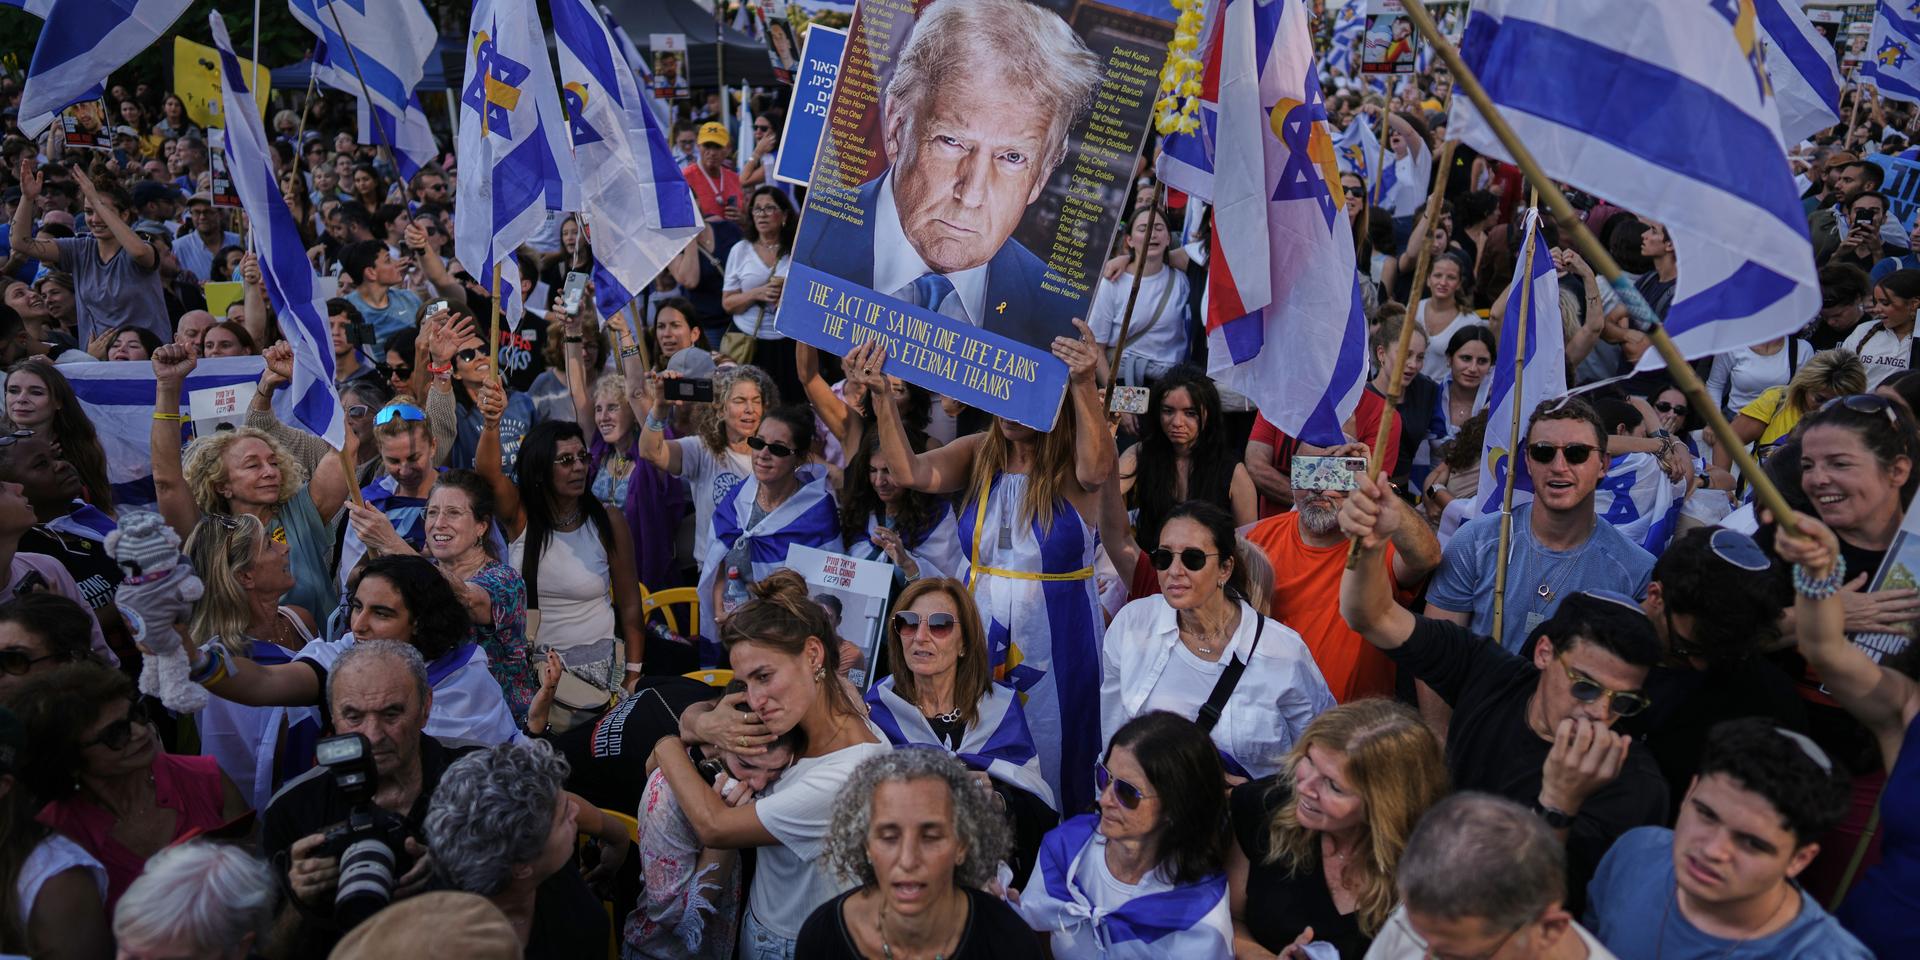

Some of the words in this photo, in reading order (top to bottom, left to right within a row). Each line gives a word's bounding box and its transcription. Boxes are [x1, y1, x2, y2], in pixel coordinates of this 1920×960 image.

[1113, 46, 1132, 57] David
[1132, 50, 1150, 63] Kunio
[1109, 58, 1132, 70] Eliyahu
[808, 74, 836, 89] כינו,
[840, 86, 861, 98] Nimrod
[861, 92, 878, 103] Cohen
[1121, 84, 1144, 97] Baruch
[817, 91, 831, 103] ים
[804, 103, 827, 117] בית
[1096, 101, 1108, 112] Guy
[836, 106, 848, 115] Alon
[849, 110, 862, 120] Ohel
[1092, 112, 1102, 120] Tal
[1088, 122, 1105, 132] Yossi
[849, 133, 865, 144] David
[1085, 132, 1106, 145] Manny
[1106, 138, 1133, 152] Goddard
[1080, 142, 1101, 154] Daniel
[1092, 156, 1108, 168] Chen
[1072, 174, 1082, 182] Oz
[1081, 177, 1102, 188] Daniel
[1095, 170, 1114, 182] Goldin
[815, 184, 825, 193] Guy
[1078, 210, 1098, 222] Baruch
[1069, 248, 1084, 259] Levy
[1066, 258, 1082, 268] Kunio
[1041, 282, 1060, 294] Maxim
[1068, 279, 1090, 292] Cooper
[809, 280, 834, 308] THE
[835, 292, 864, 319] ACT
[865, 302, 886, 325] OF
[886, 310, 932, 348] SAVING
[934, 326, 962, 354] ONE
[960, 335, 992, 366] LIFE
[992, 349, 1040, 383] EARNS
[822, 312, 848, 340] THE
[900, 342, 959, 383] ETERNAL
[964, 364, 1014, 401] THANKS
[1861, 355, 1873, 364] OS
[1875, 356, 1906, 368] ANGE
[823, 565, 838, 575] ARIEL
[840, 568, 856, 578] CUNIO
[824, 574, 839, 585] (27)
[77, 574, 111, 600] RING
